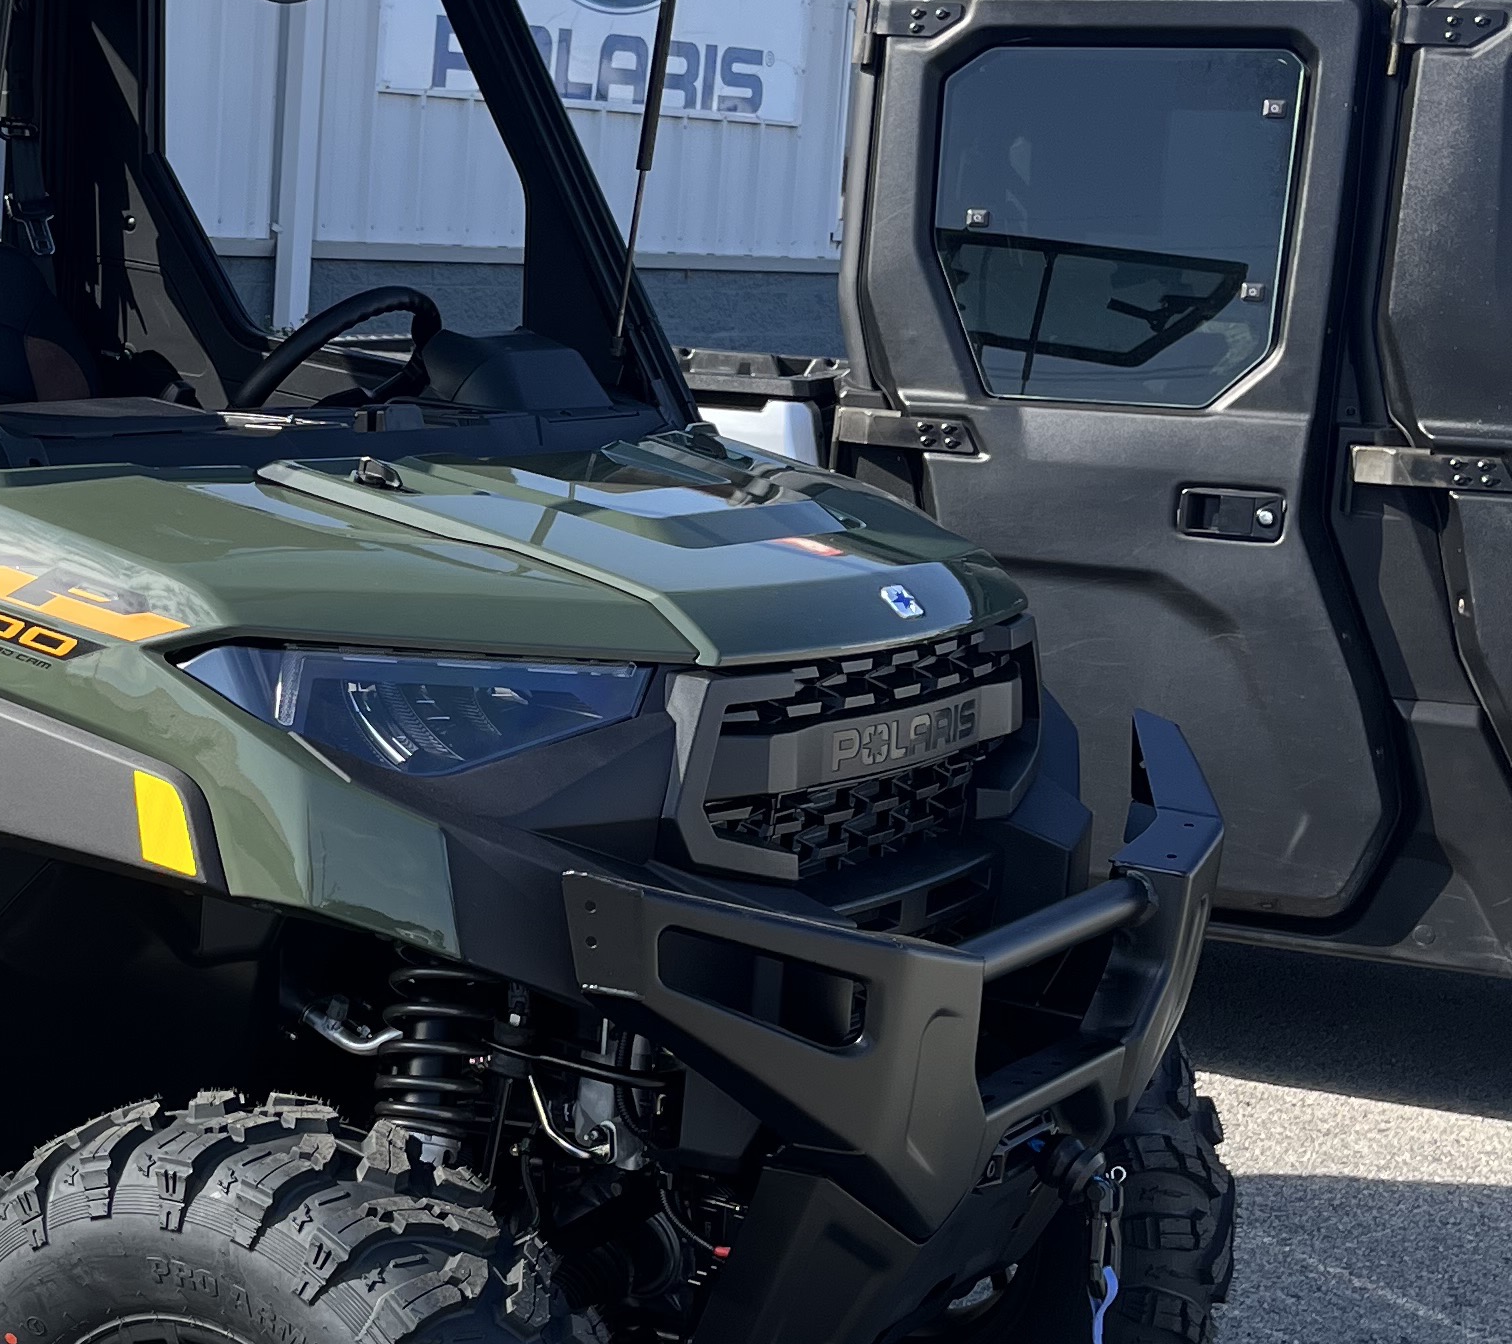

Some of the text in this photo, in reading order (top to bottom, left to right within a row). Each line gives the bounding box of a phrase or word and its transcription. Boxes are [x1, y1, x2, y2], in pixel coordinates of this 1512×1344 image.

[432, 14, 764, 115] PLARIS
[15, 653, 53, 671] CAM
[831, 697, 978, 772] POLARIS
[145, 1256, 219, 1299] PRO
